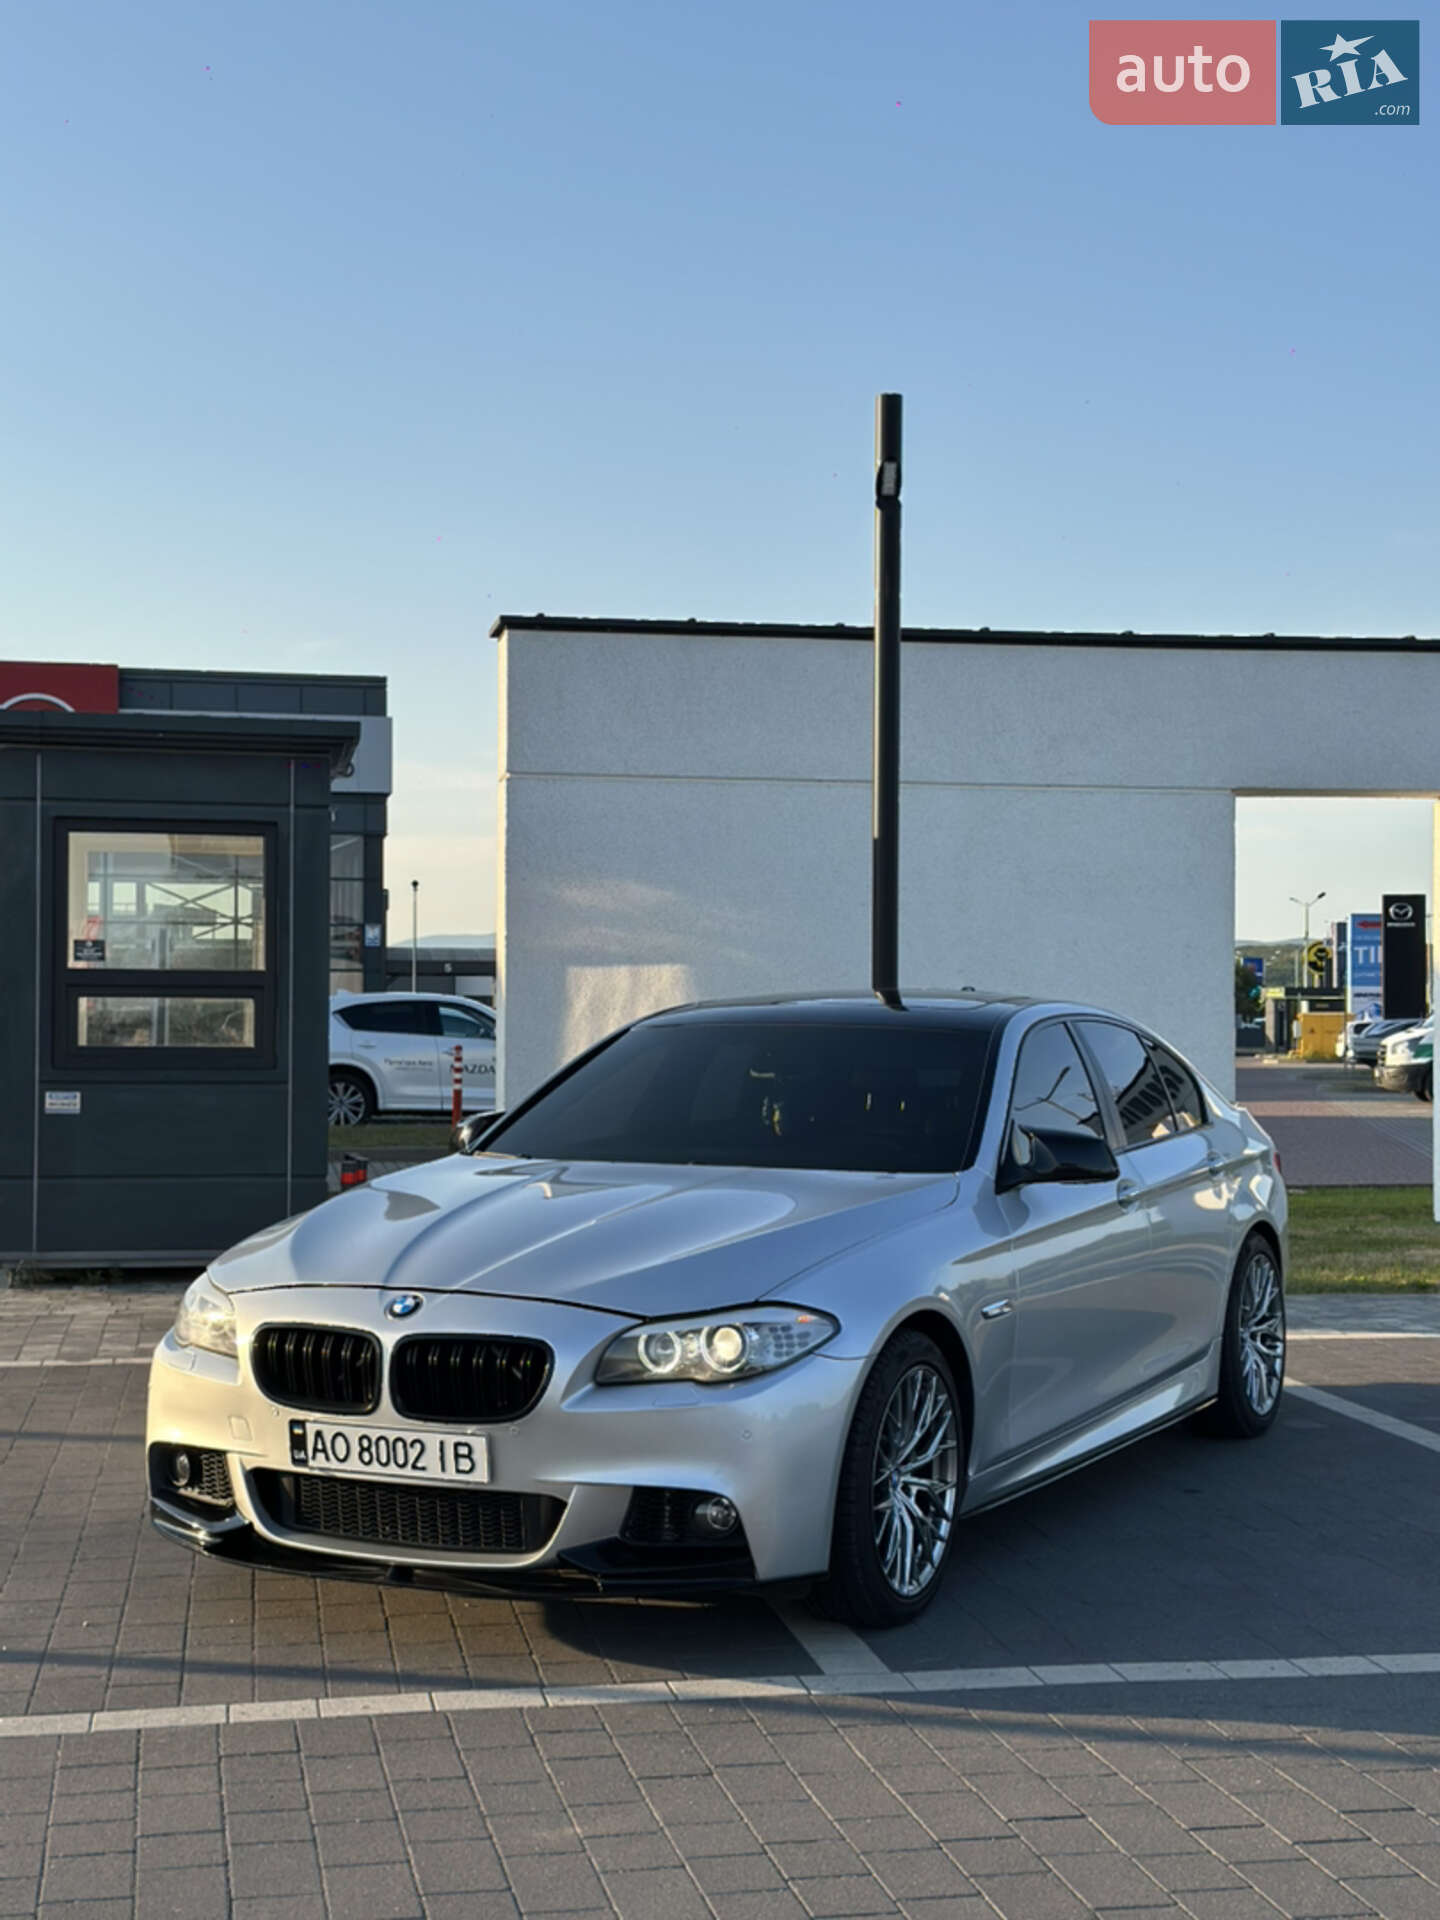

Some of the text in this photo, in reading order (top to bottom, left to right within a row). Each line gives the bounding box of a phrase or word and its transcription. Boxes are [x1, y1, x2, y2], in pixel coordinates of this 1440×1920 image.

[311, 1429, 476, 1474] AO 8002 IB
